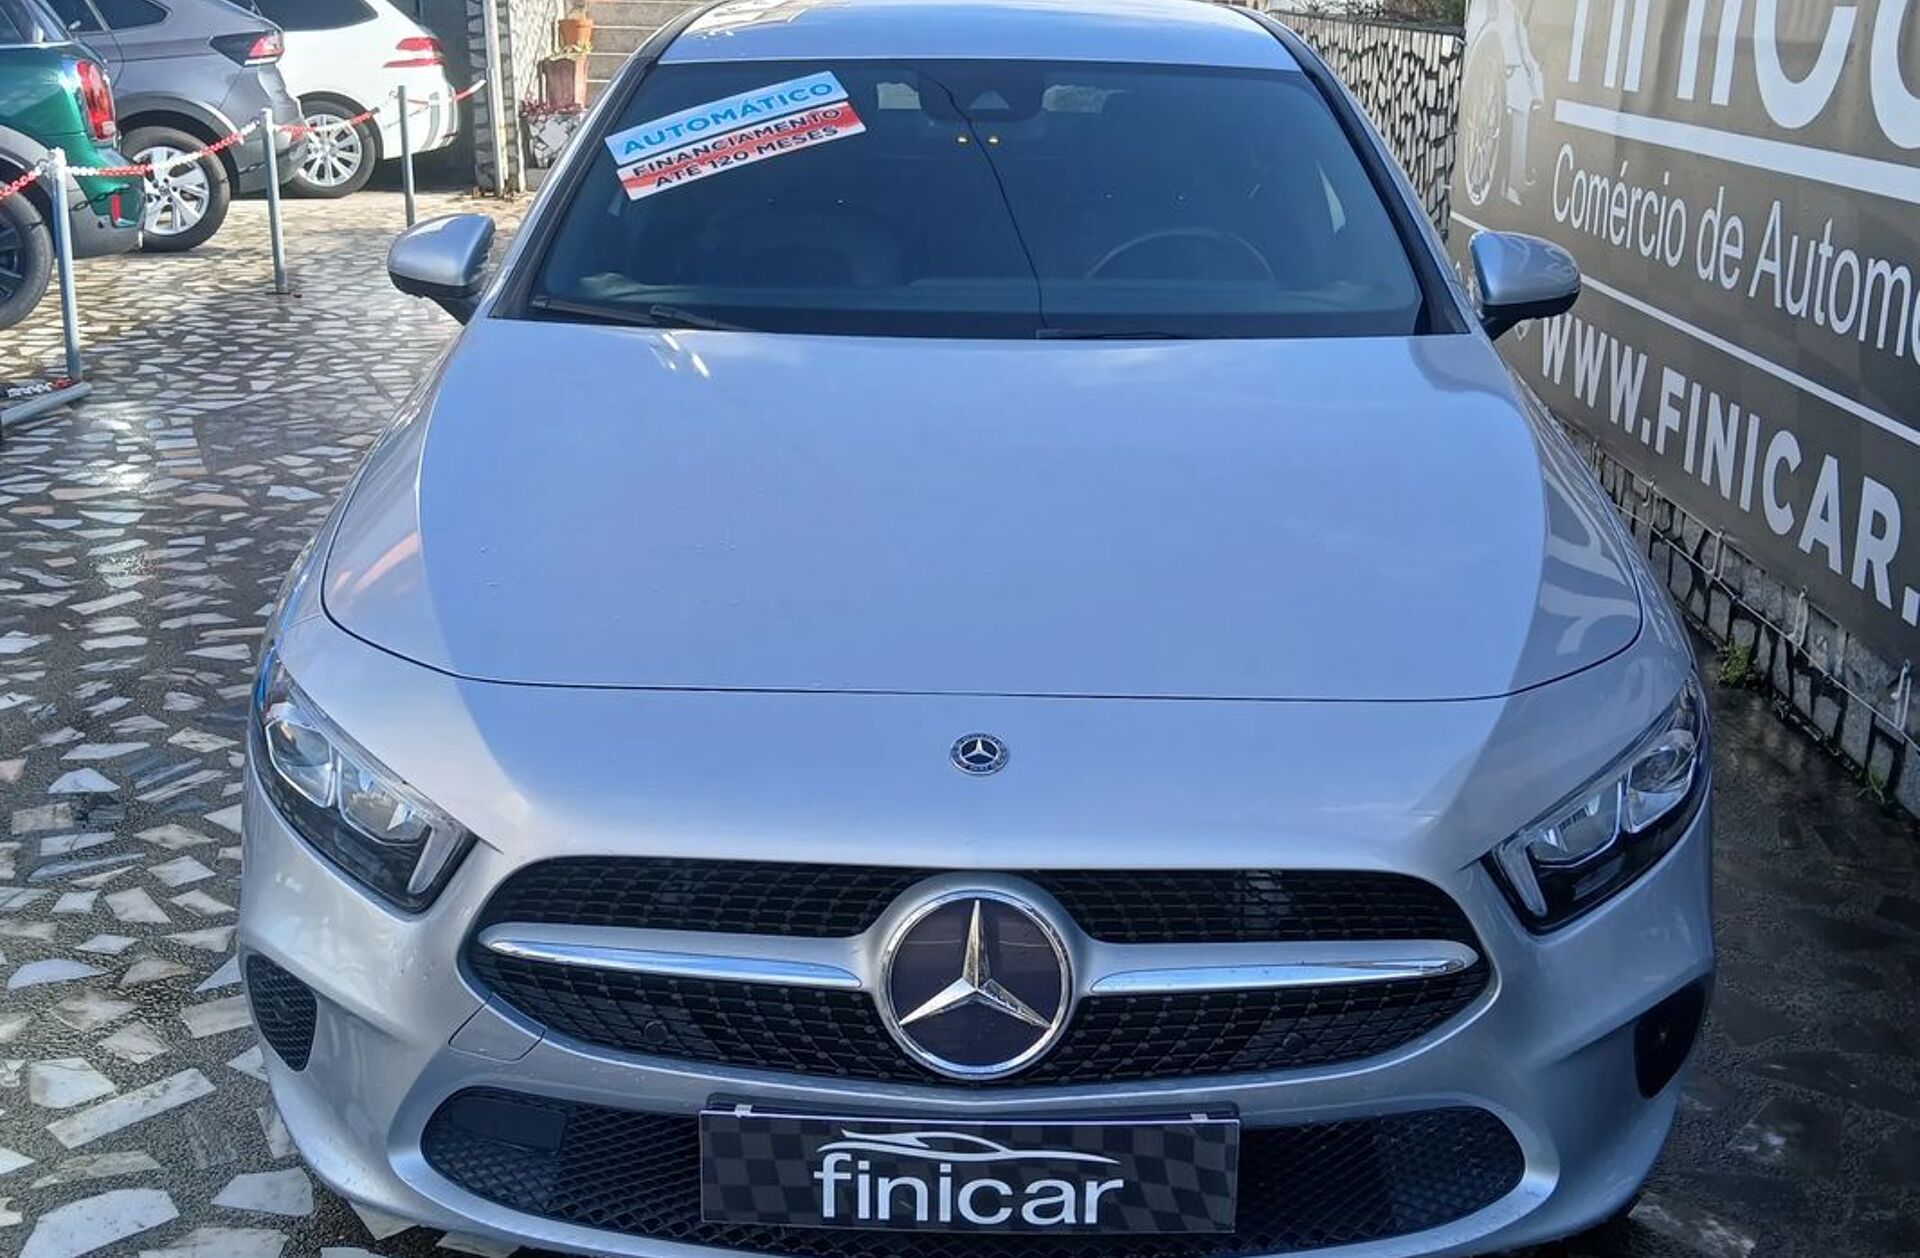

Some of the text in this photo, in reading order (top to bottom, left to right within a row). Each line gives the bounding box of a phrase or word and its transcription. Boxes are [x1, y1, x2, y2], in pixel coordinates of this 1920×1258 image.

[633, 108, 840, 177] FINANCIAMENTO
[709, 150, 749, 170] 120
[756, 126, 839, 155] MESES
[1552, 143, 1920, 366] Comércio de Autom
[813, 1152, 1124, 1226] finicar
